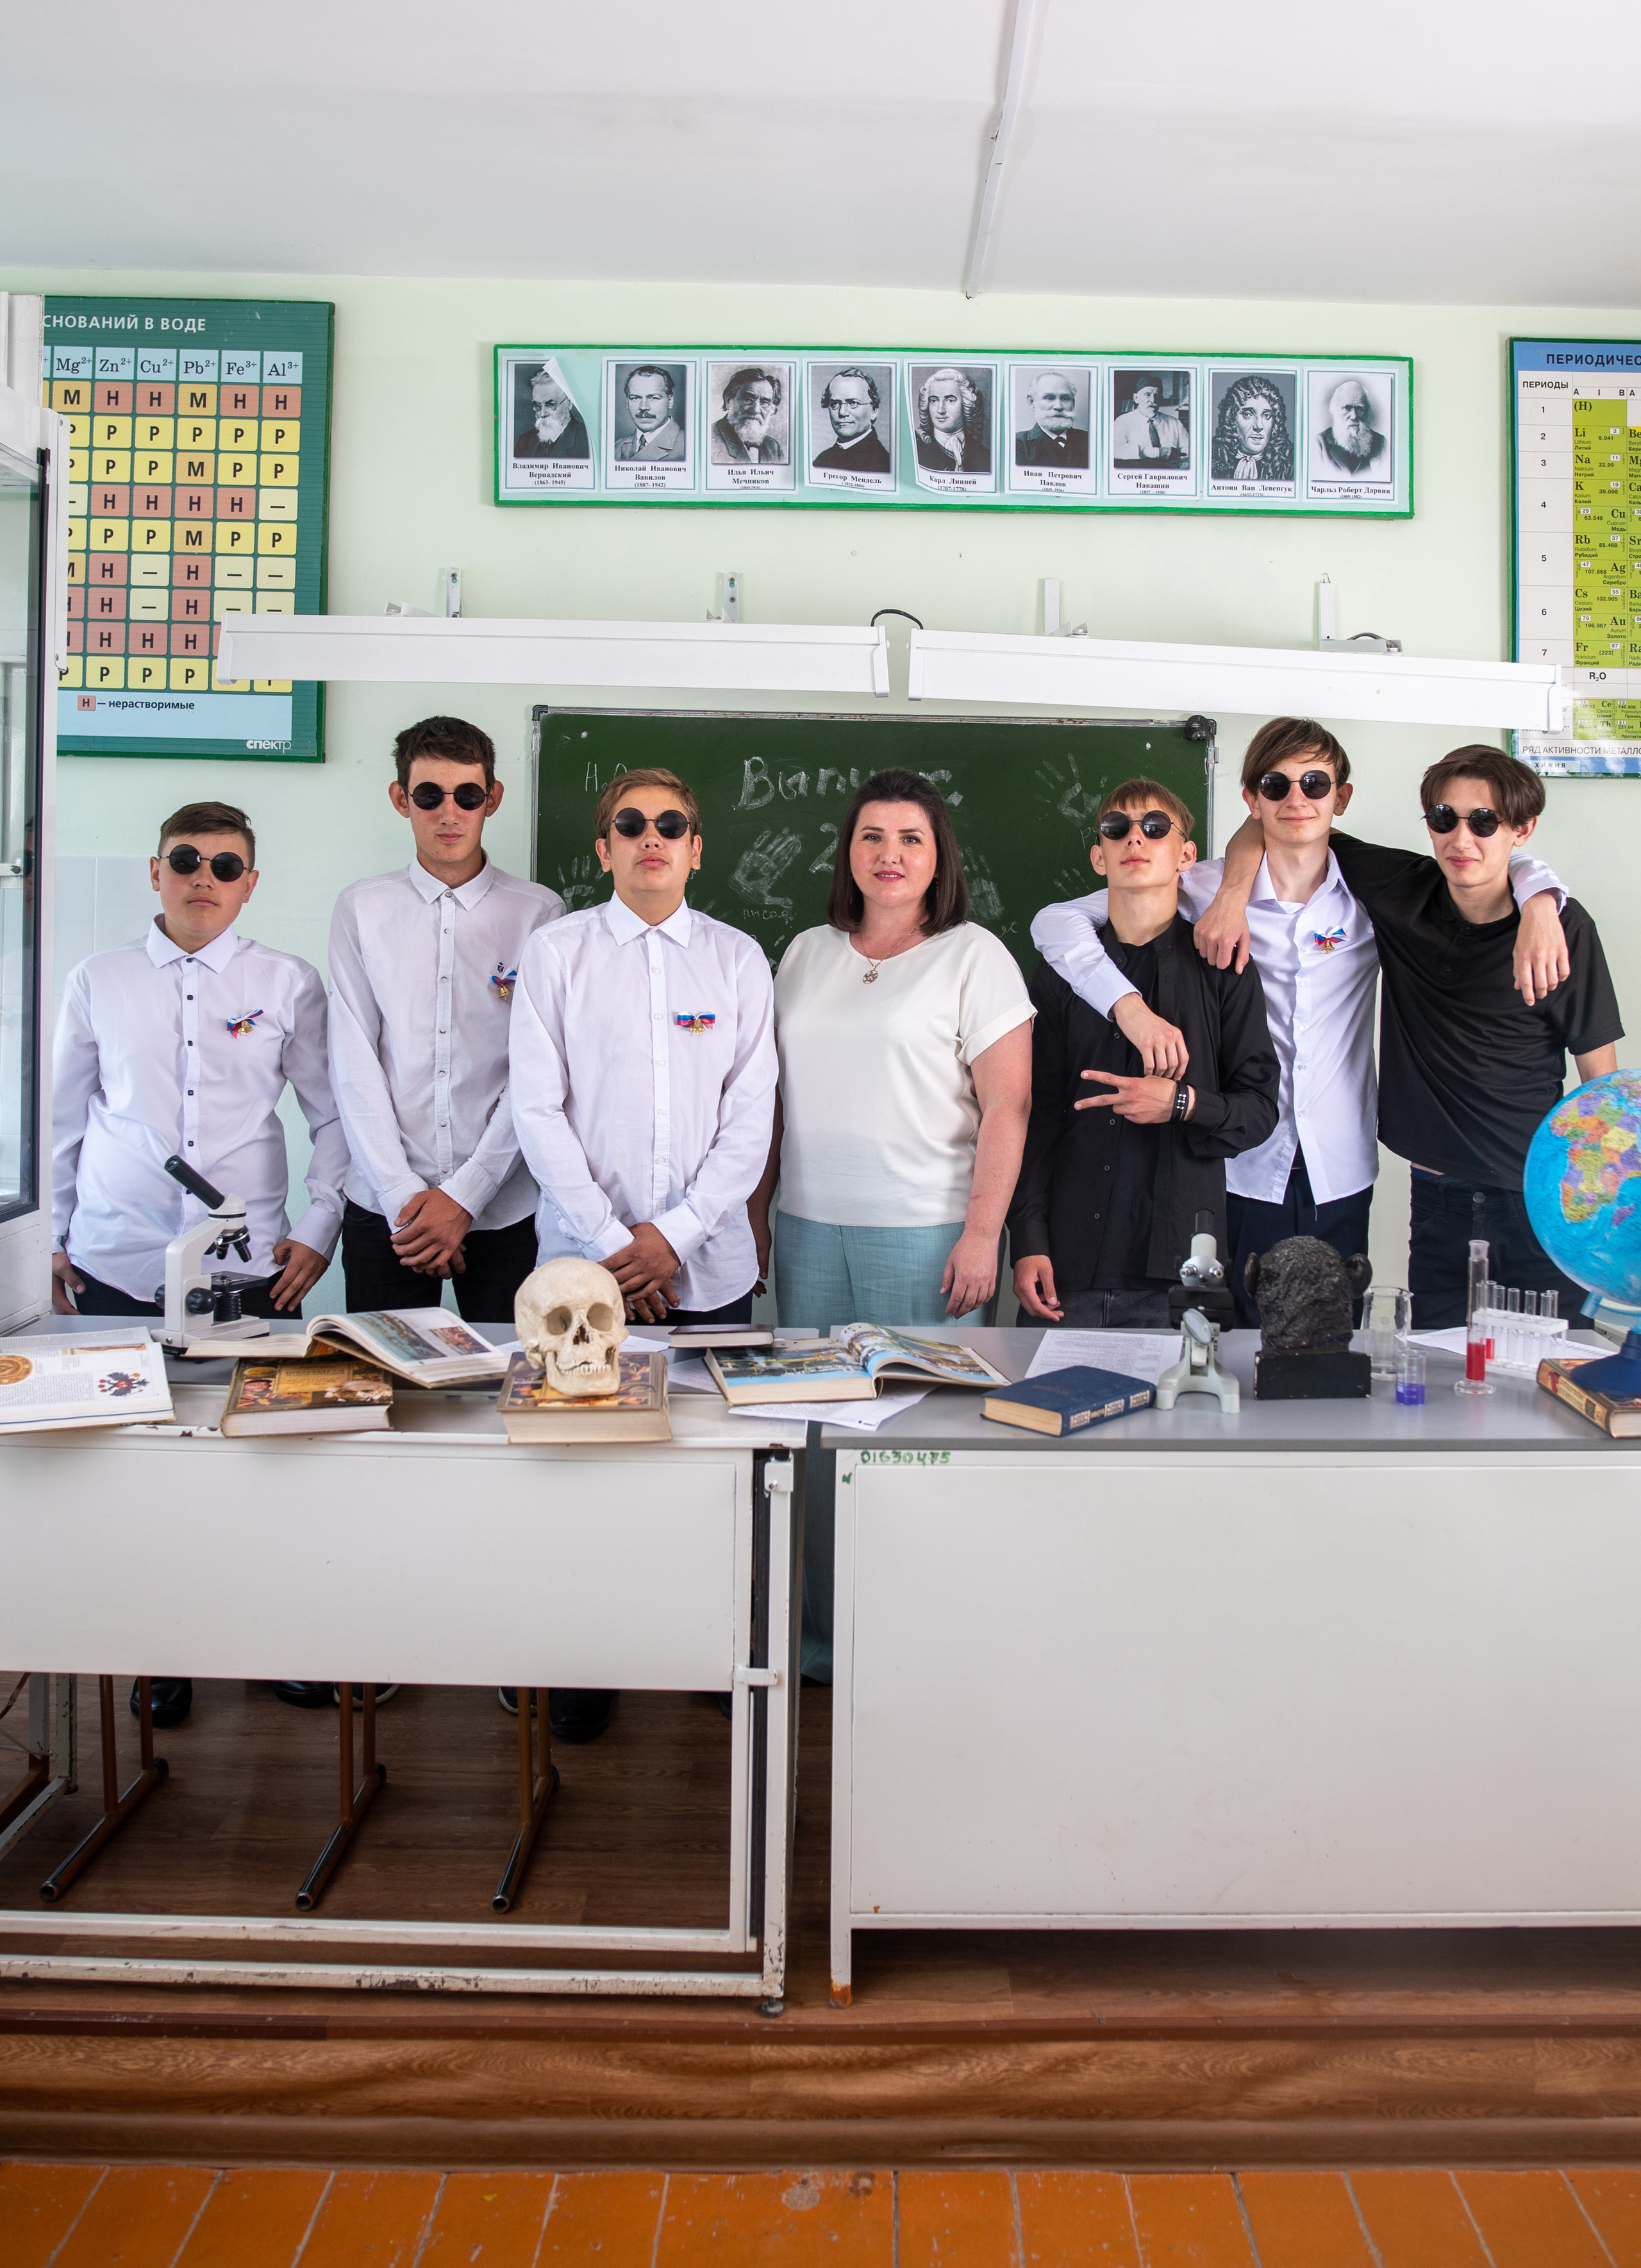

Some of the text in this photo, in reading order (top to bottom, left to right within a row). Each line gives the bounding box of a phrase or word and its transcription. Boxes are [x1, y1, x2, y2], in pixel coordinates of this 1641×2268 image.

[145, 317, 154, 330] В
[160, 317, 206, 333] ВОДЕ
[1522, 381, 1569, 390] ПЕРИОДЫ
[63, 389, 287, 410] М Н Н М Н Н
[1574, 401, 1592, 412] (H)
[107, 424, 285, 444] Р Р Р Р Р
[1574, 428, 1586, 437] Li
[1575, 454, 1591, 464] Na
[106, 459, 285, 479] Р Р М Р Р
[512, 462, 549, 471] Владимир
[529, 471, 571, 479] Вернадский
[823, 472, 882, 485] Грегор Мендель
[929, 475, 945, 485] Карл
[1048, 471, 1082, 480] Петрович
[1144, 473, 1188, 481] Гаврилович
[1258, 485, 1292, 493] Левенгук
[1311, 486, 1390, 495] Чарльз Роберт Дарвин
[1575, 481, 1585, 490] K
[103, 494, 243, 513] Н Н Н Н
[1611, 508, 1626, 519] Cu
[104, 528, 282, 548] Р Р М Р Р
[1575, 535, 1590, 544] Rb
[101, 562, 199, 581] Н Н
[1610, 562, 1626, 574] Ag
[1575, 588, 1588, 598] Cs
[101, 597, 198, 615] Н Н
[1610, 616, 1626, 626] Au
[99, 631, 197, 650] Н Н Н
[1576, 642, 1588, 652] Fr
[99, 666, 196, 684] Р Р Р
[82, 698, 195, 711] Н нерастворимые
[1522, 746, 1541, 755] РЯД
[1543, 746, 1601, 755] АКТИВНОСТИ
